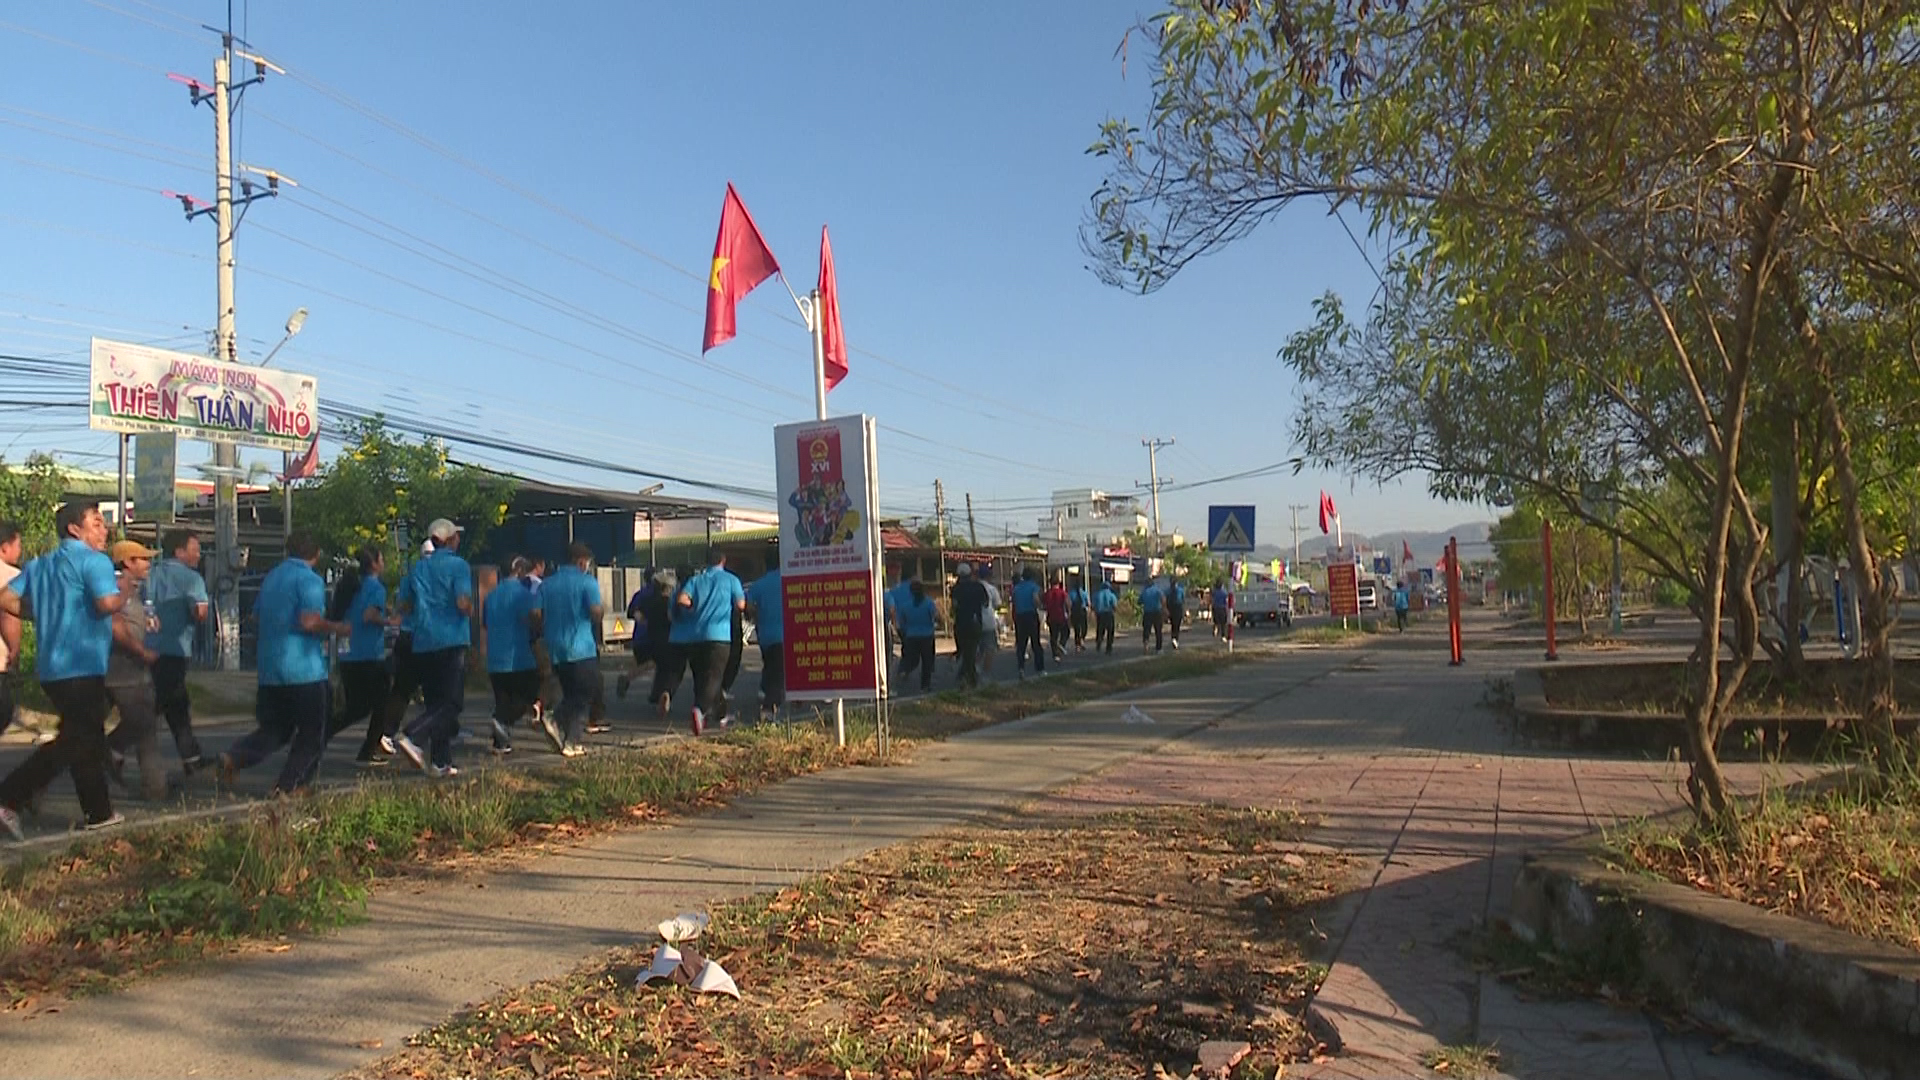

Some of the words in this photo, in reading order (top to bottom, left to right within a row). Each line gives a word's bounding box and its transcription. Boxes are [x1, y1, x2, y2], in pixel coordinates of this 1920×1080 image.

[225, 369, 257, 387] NON
[192, 389, 254, 430] THẦN
[267, 402, 311, 438] NHỎ
[811, 461, 830, 473] XVI
[808, 581, 822, 593] LIỆT
[824, 580, 843, 592] CHÀO
[788, 597, 807, 608] NGÀY
[808, 595, 823, 607] BẦU
[825, 594, 834, 606] CỬ
[835, 595, 848, 607] ĐẠI
[849, 592, 865, 605] BIỂU
[795, 611, 813, 623] QUỐC
[849, 611, 861, 619] XVI
[808, 626, 817, 637] VÀ
[818, 626, 831, 637] ĐẠI
[832, 622, 848, 635] BIỂU
[849, 639, 864, 649] DÂN
[797, 655, 811, 667] CÁC
[812, 653, 826, 666] CẤP
[808, 672, 825, 681] 2026
